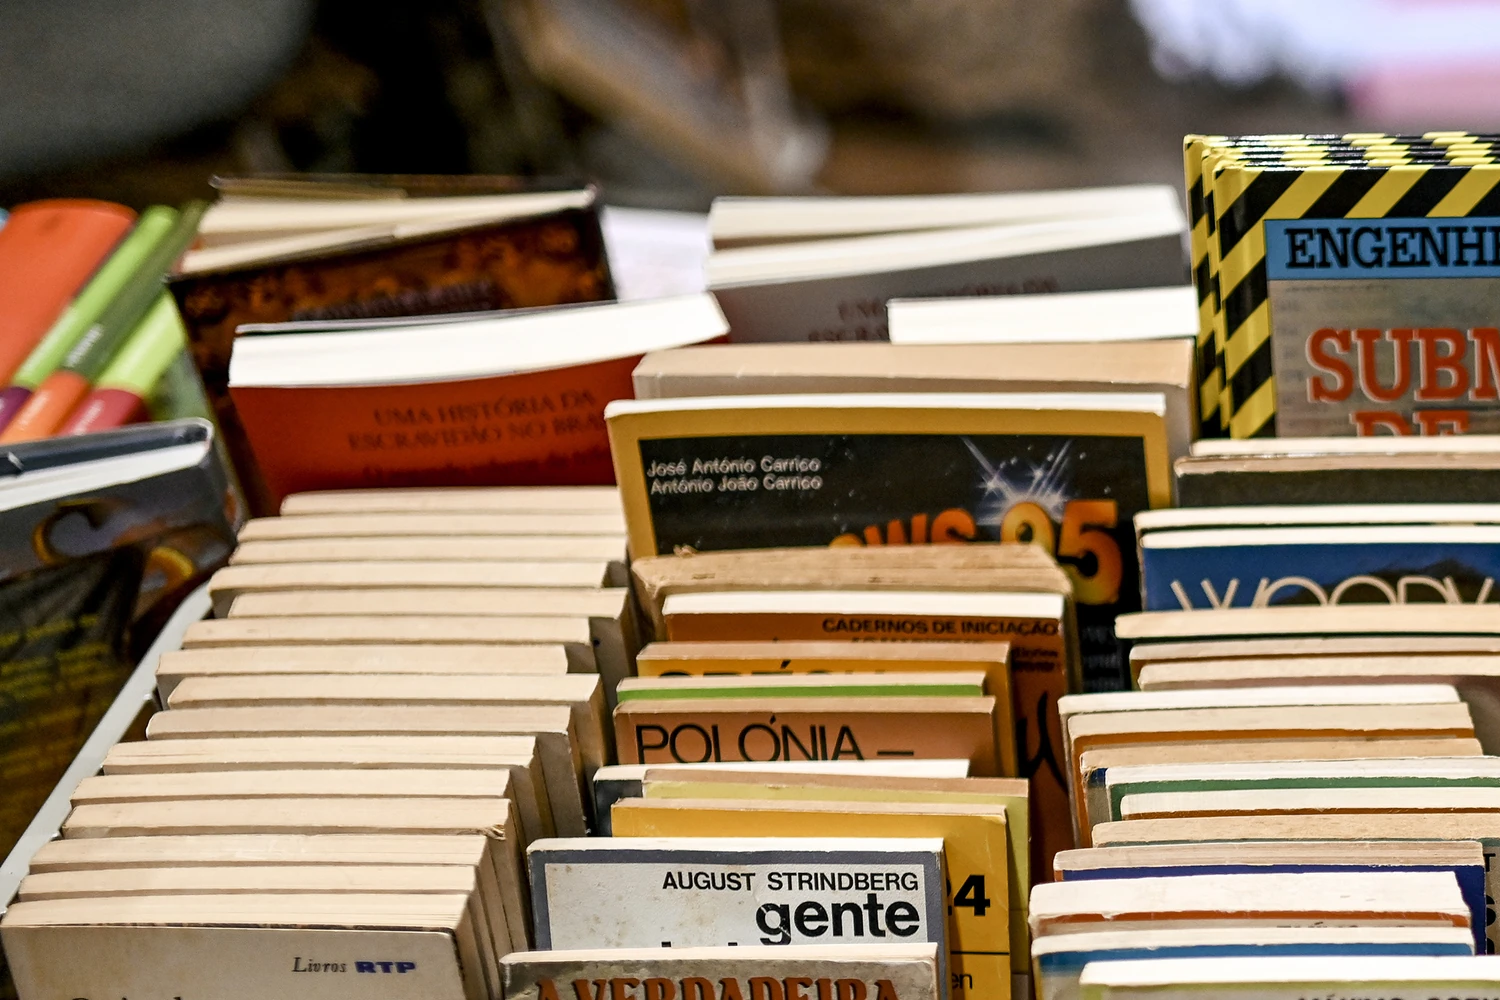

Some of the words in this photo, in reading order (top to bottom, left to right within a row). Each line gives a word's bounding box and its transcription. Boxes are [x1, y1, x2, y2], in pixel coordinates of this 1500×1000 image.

[647, 457, 687, 478] José
[691, 456, 756, 475] António
[650, 477, 714, 495] António
[717, 474, 759, 492] João
[822, 618, 928, 634] CADERNOS
[932, 619, 956, 635] DE
[960, 617, 1060, 636] INICIAÇÃO
[635, 714, 865, 764] POLÓNIA
[662, 871, 756, 891] AUGUST
[767, 871, 919, 892] STRINDBERG
[946, 873, 991, 917] 4
[755, 892, 920, 945] gente
[293, 957, 347, 975] Livros
[355, 959, 416, 974] RTP
